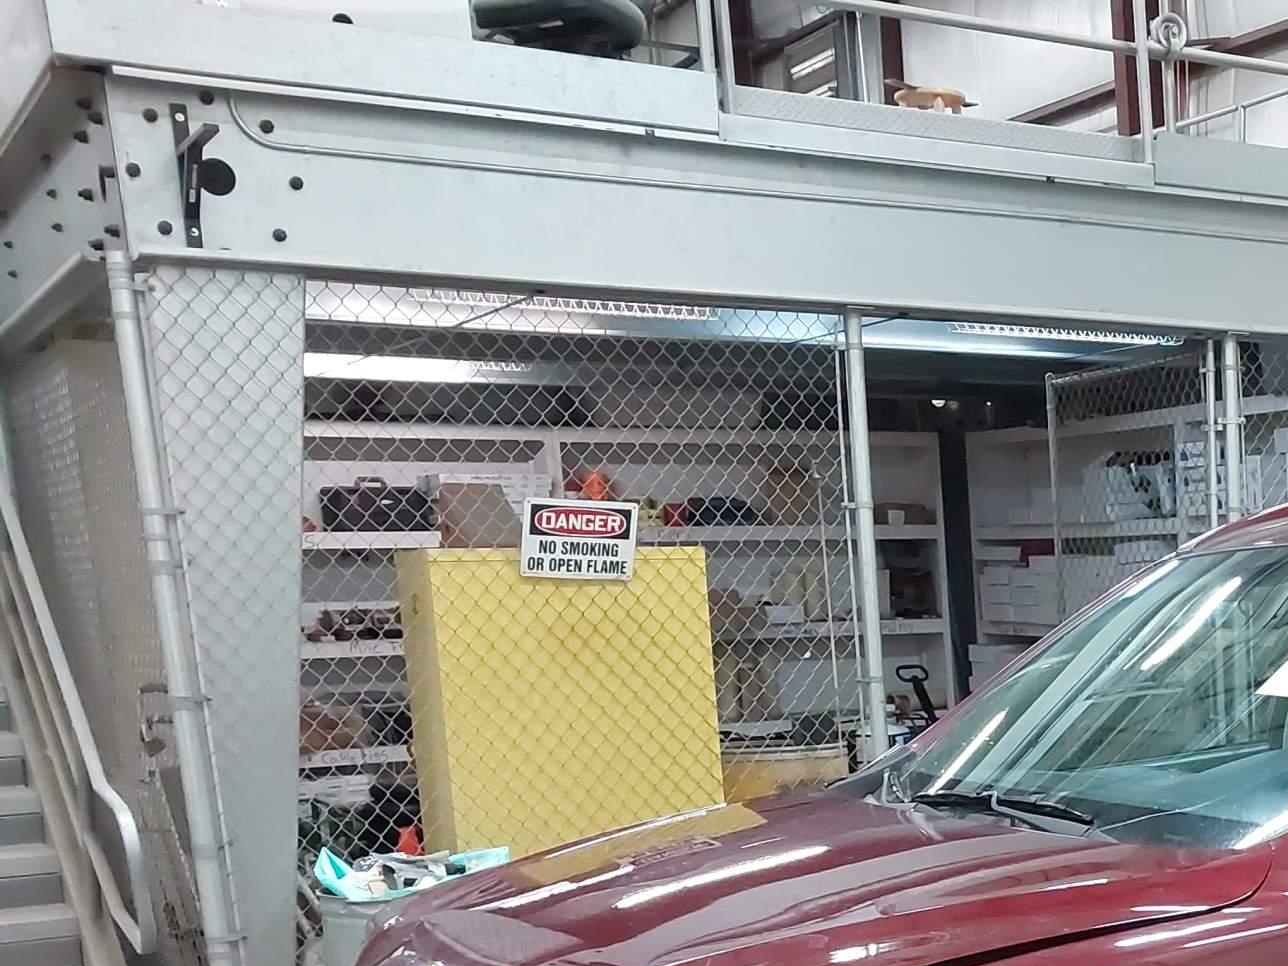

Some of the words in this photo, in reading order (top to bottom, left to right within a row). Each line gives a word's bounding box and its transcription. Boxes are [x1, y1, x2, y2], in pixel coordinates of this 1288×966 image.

[541, 512, 621, 532] DANGER
[538, 540, 557, 554] NO
[561, 541, 619, 557] SMOKING
[527, 557, 545, 571] OR
[548, 558, 583, 573] OPEN
[586, 559, 628, 575] FLAME
